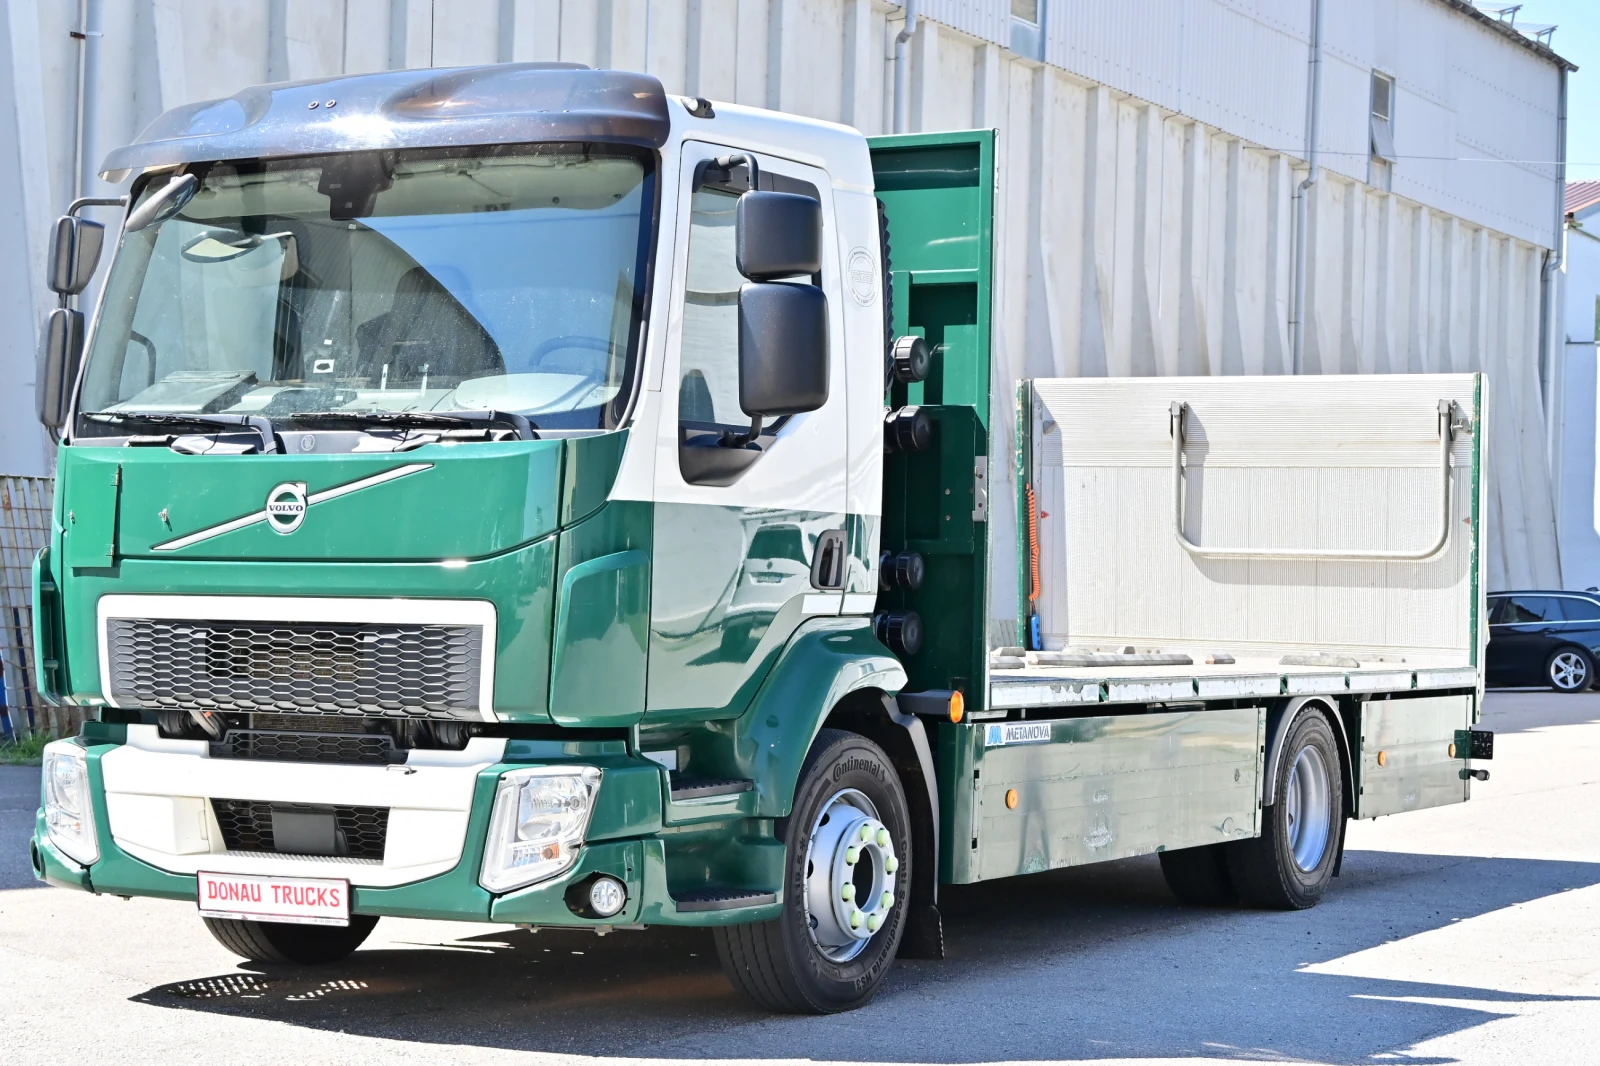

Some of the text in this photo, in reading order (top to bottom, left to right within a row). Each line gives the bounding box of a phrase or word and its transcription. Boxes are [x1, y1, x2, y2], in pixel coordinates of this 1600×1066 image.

[268, 504, 304, 512] VOLVO
[1005, 725, 1050, 741] METANOVA
[833, 756, 881, 782] Continental
[900, 840, 908, 884] Conti
[207, 880, 341, 908] DONAU TRUCKS
[872, 889, 906, 975] Scandinavia
